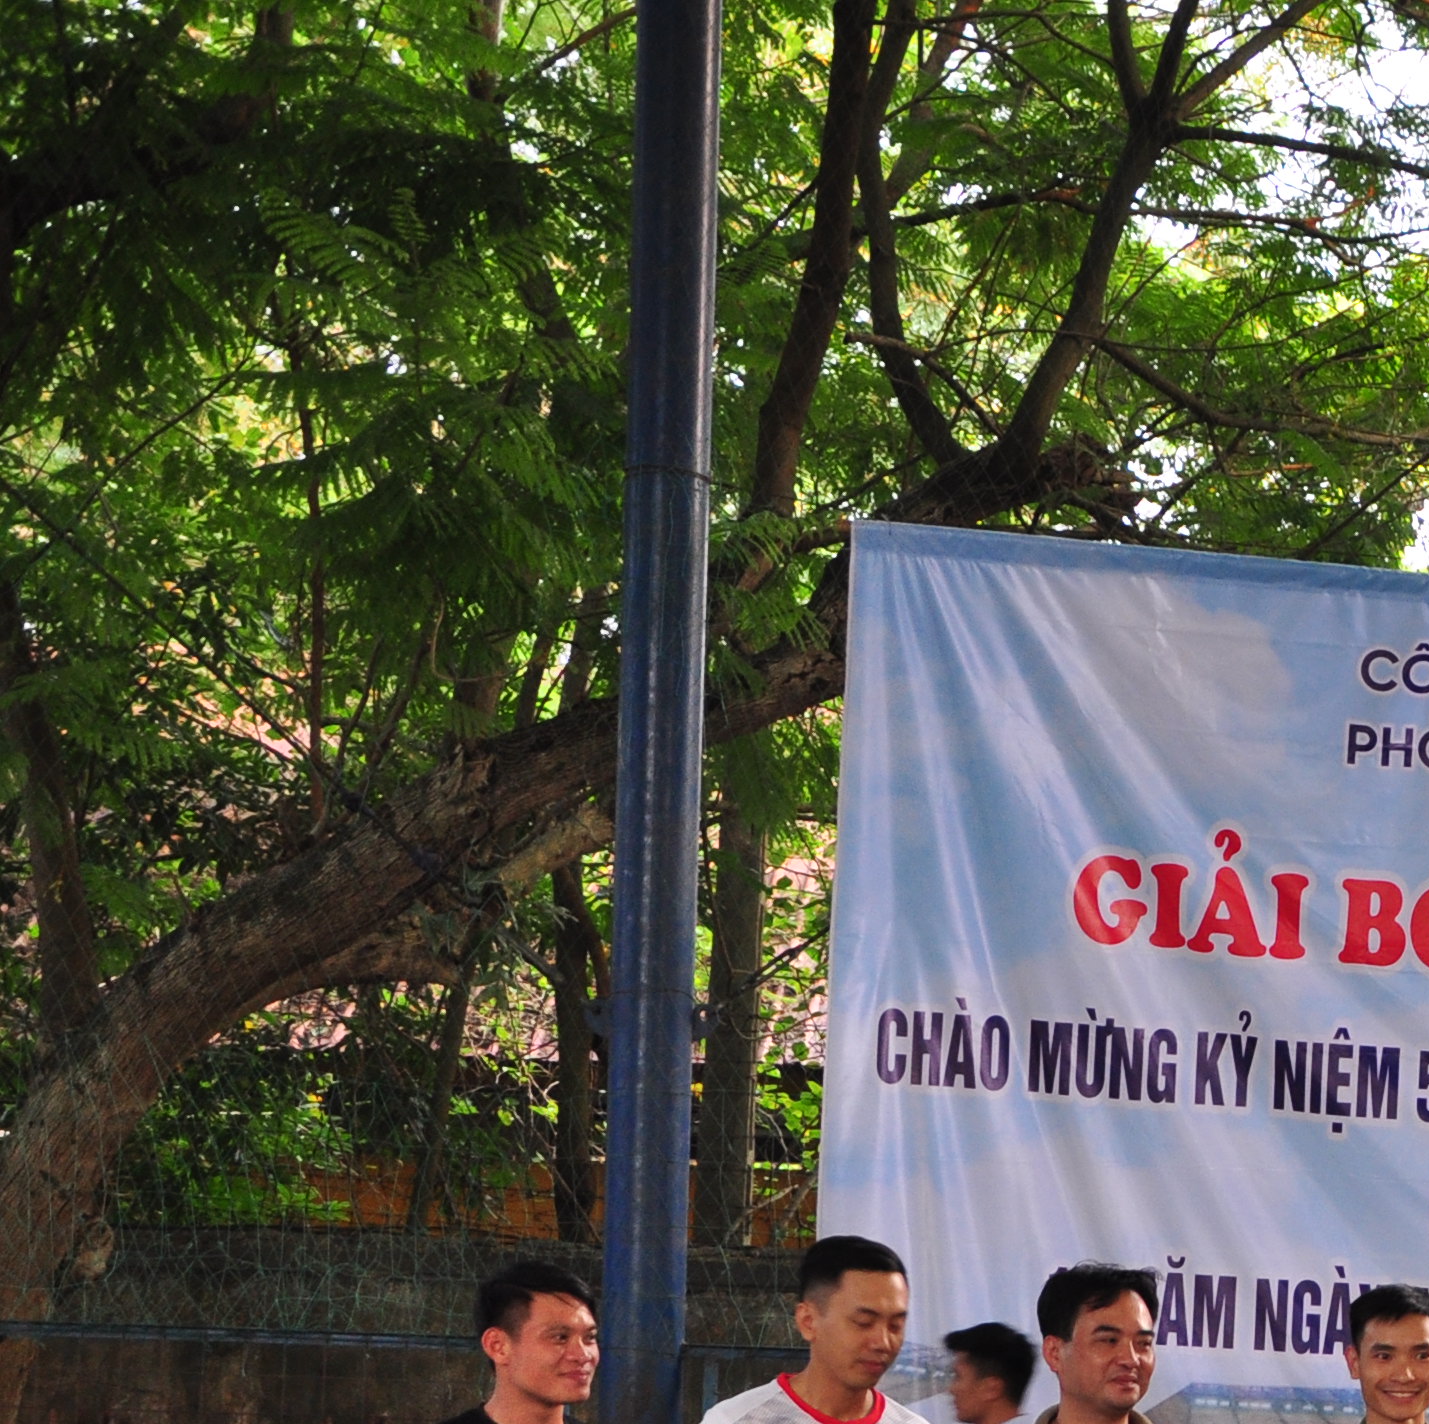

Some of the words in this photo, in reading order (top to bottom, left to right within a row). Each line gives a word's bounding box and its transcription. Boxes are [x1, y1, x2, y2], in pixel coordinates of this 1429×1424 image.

[1073, 828, 1309, 961] GIẢI
[875, 999, 1012, 1091] CHÀO
[1028, 1008, 1178, 1105] MỪNG
[1194, 1011, 1258, 1108] KỶ
[1273, 1028, 1401, 1134] NIỆM
[1156, 1256, 1237, 1349] ĂM
[1254, 1264, 1378, 1355] NGÀ
